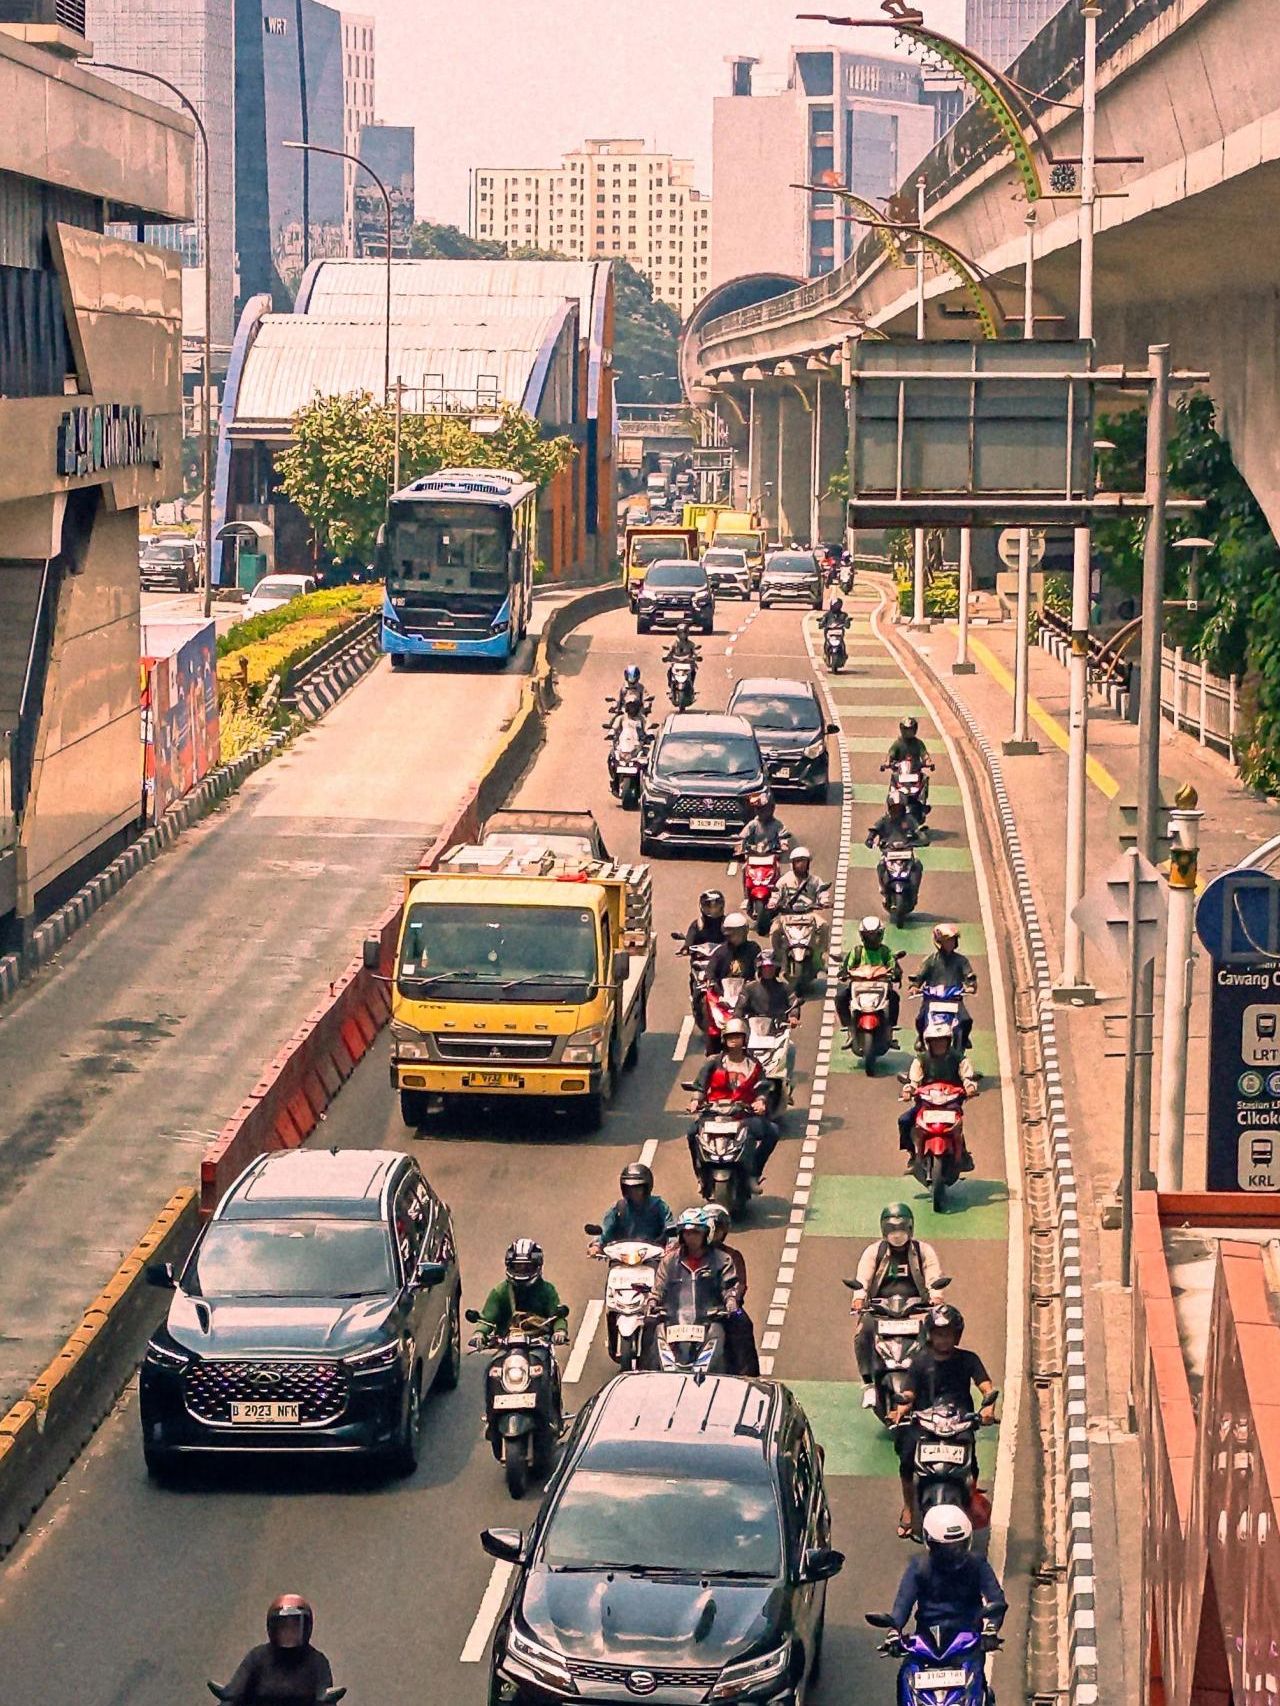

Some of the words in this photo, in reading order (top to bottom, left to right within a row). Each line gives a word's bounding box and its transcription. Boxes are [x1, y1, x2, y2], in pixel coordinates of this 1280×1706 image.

[1218, 971, 1270, 990] Cawang
[1253, 1049, 1278, 1061] LRT
[1237, 1100, 1269, 1110] Stasiun
[1249, 1175, 1275, 1187] KRL
[278, 1405, 297, 1417] NFK
